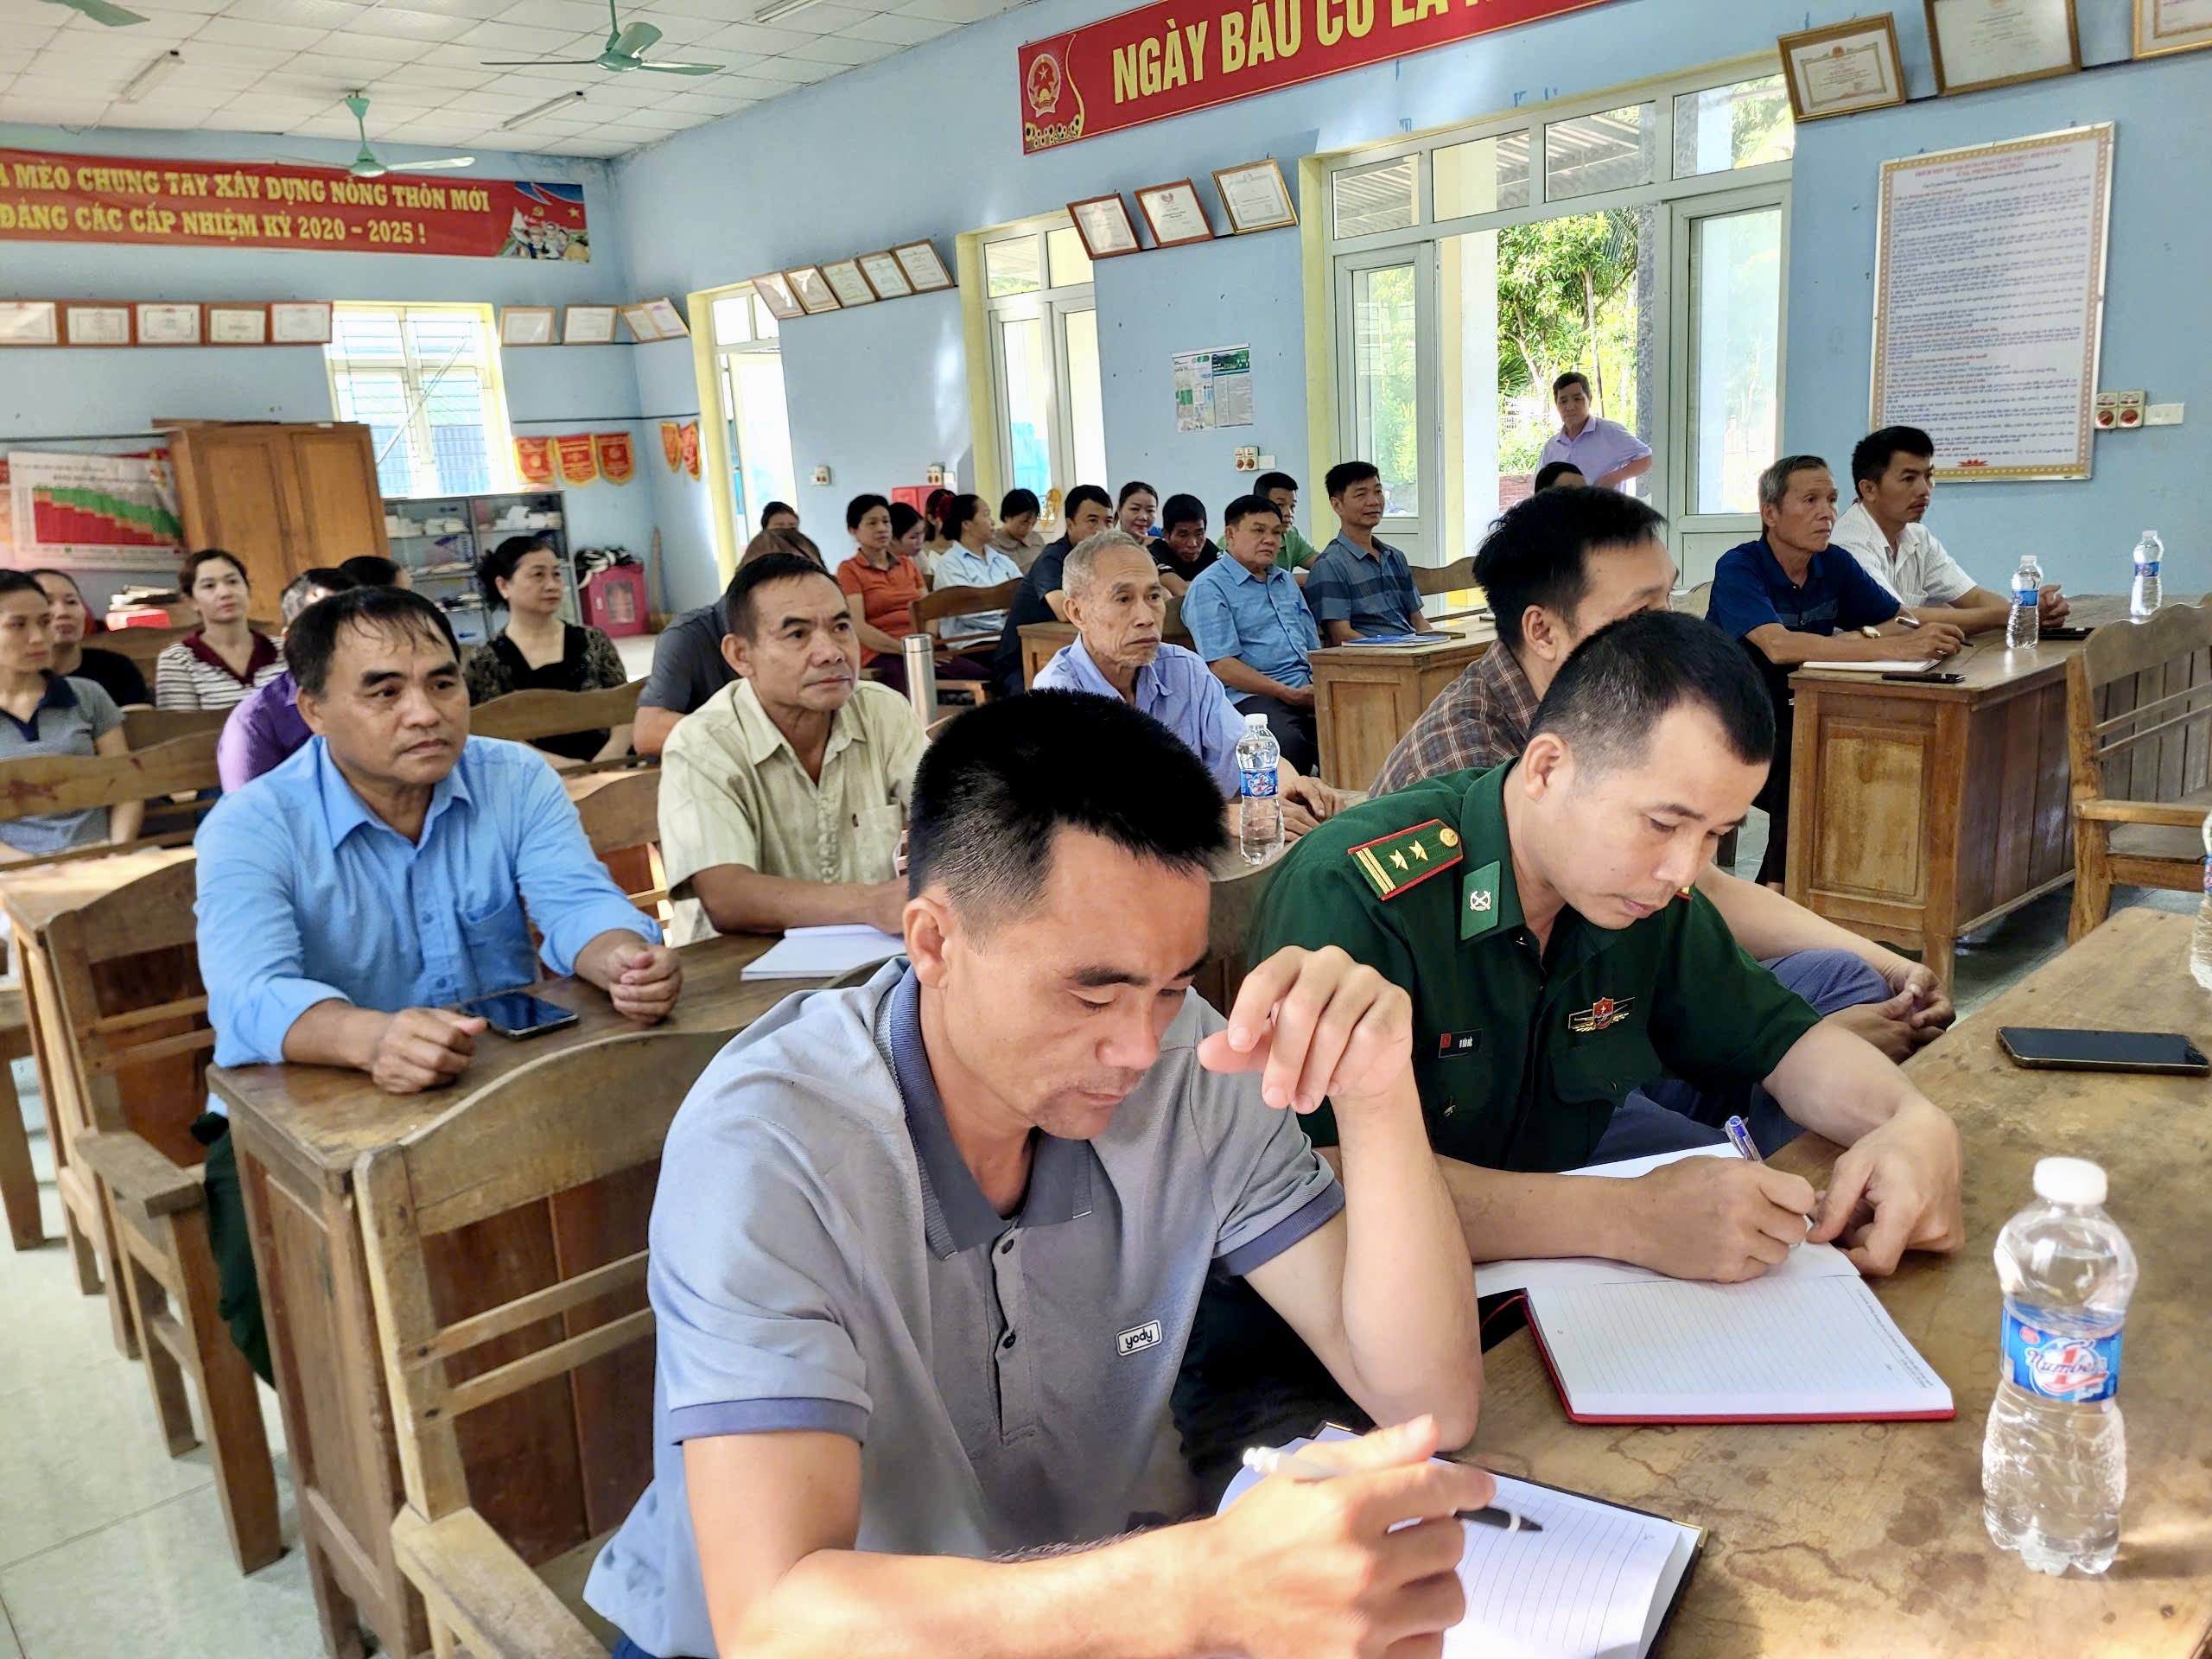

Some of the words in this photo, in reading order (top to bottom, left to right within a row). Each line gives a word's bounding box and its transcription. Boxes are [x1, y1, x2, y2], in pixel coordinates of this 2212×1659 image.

[1112, 18, 1208, 105] NGÀY
[77, 167, 161, 194] CHUNG
[164, 172, 208, 196] TAY
[213, 169, 260, 199] XÂY
[264, 175, 327, 206] DỰNG
[329, 177, 388, 207] NÔNG
[391, 182, 447, 211] THÔN
[449, 186, 491, 213] MỚI
[75, 201, 124, 232] CÁC
[130, 201, 176, 234] CẤP
[181, 207, 259, 241] NHIỆM
[297, 214, 346, 242] 2020
[367, 219, 415, 245] 2025
[1125, 1329, 1153, 1349] yody
